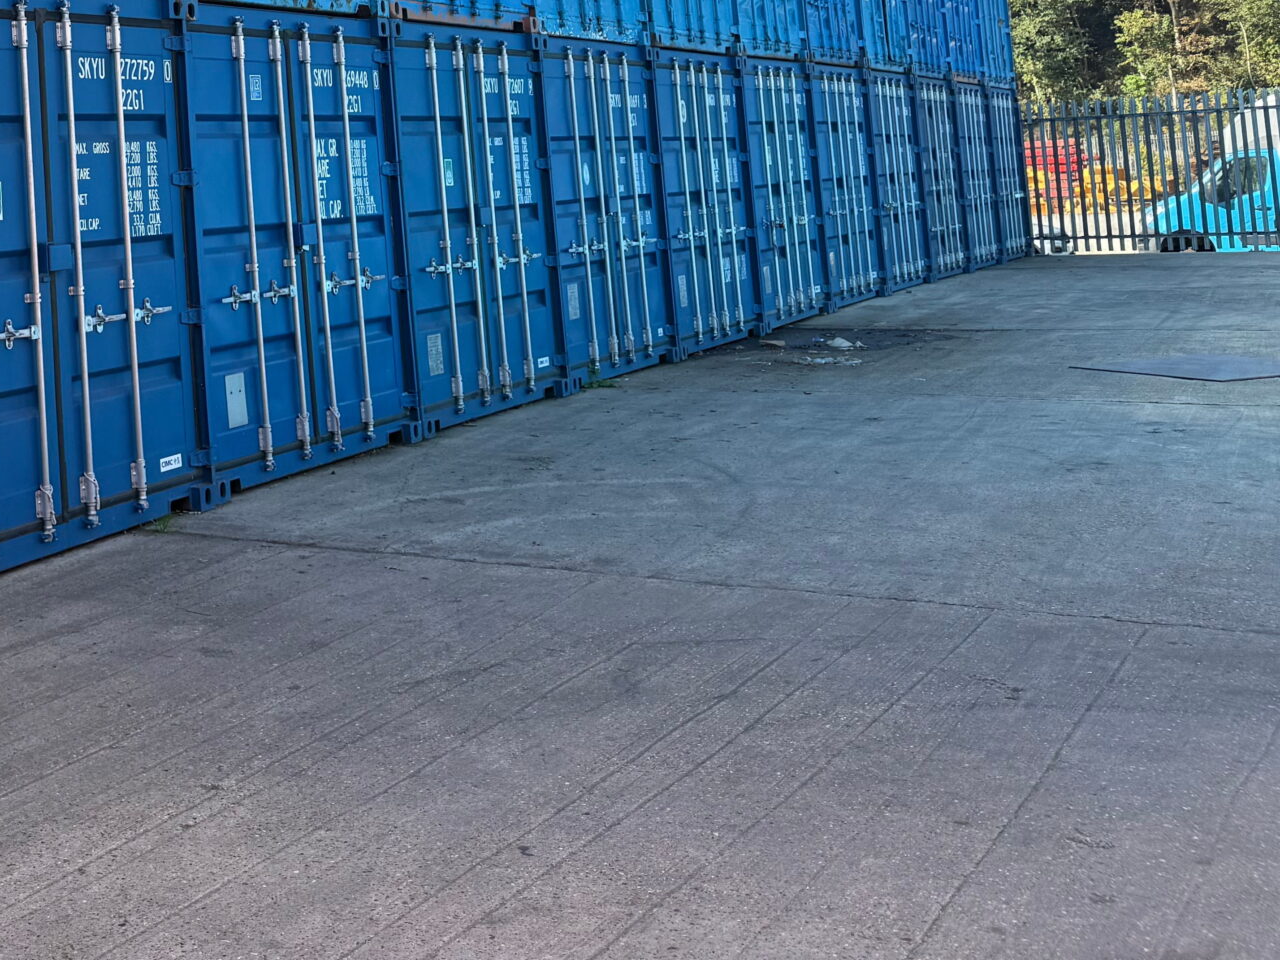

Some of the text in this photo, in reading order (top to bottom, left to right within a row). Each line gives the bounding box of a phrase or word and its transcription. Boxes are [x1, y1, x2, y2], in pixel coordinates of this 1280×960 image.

[78, 57, 105, 79] SKYU
[120, 59, 155, 80] 272759
[313, 68, 333, 87] SKYU
[121, 89, 144, 110] 22G1
[92, 142, 110, 154] GROSS
[315, 138, 327, 157] AX.
[317, 159, 331, 178] ARE
[318, 180, 327, 198] ET
[329, 200, 344, 218] CAP.
